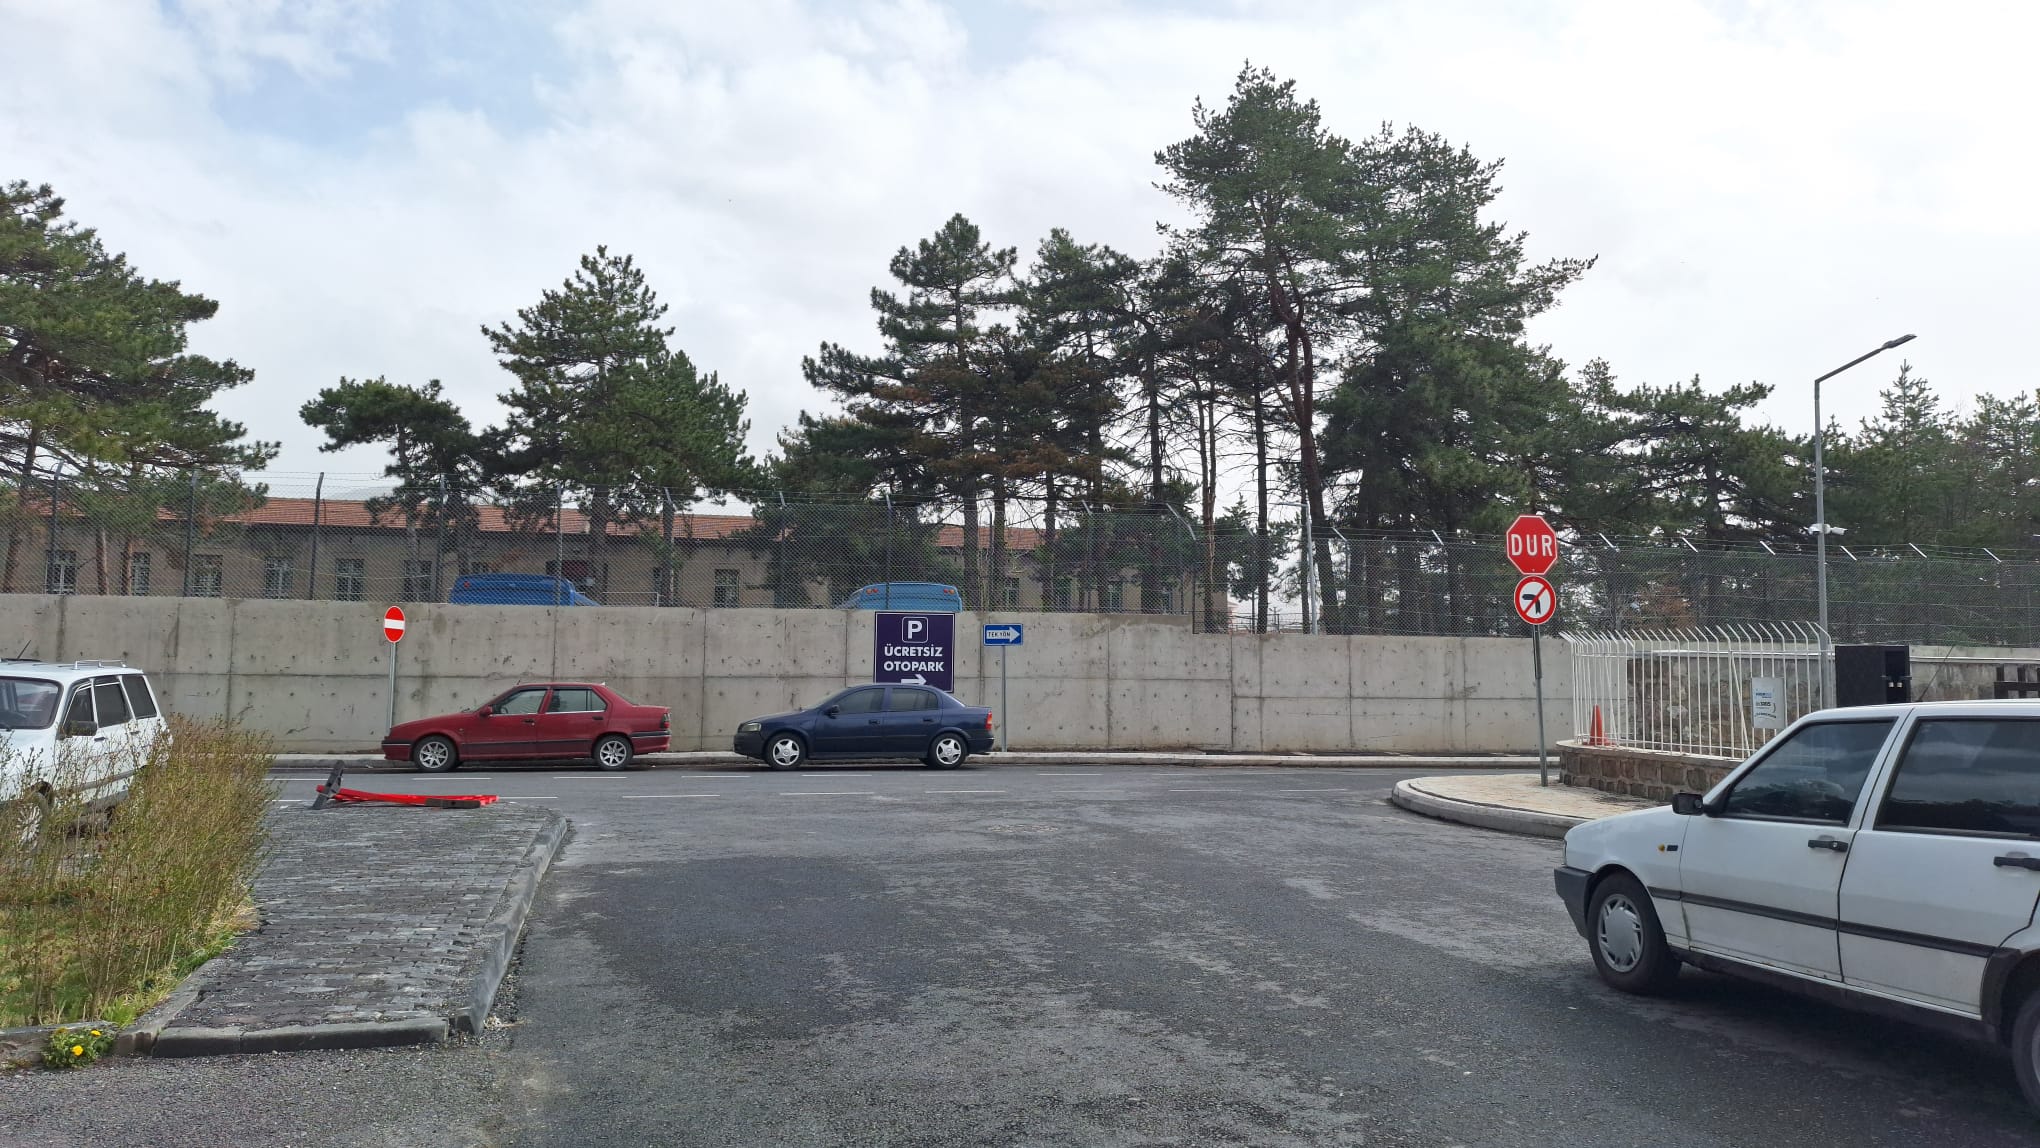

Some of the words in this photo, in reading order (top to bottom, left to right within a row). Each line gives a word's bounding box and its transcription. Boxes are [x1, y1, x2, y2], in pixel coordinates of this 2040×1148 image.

[1510, 533, 1553, 557] DUR
[907, 620, 923, 639] P
[884, 643, 943, 657] ÜCRETSİZ
[883, 660, 944, 672] OTOPARK
